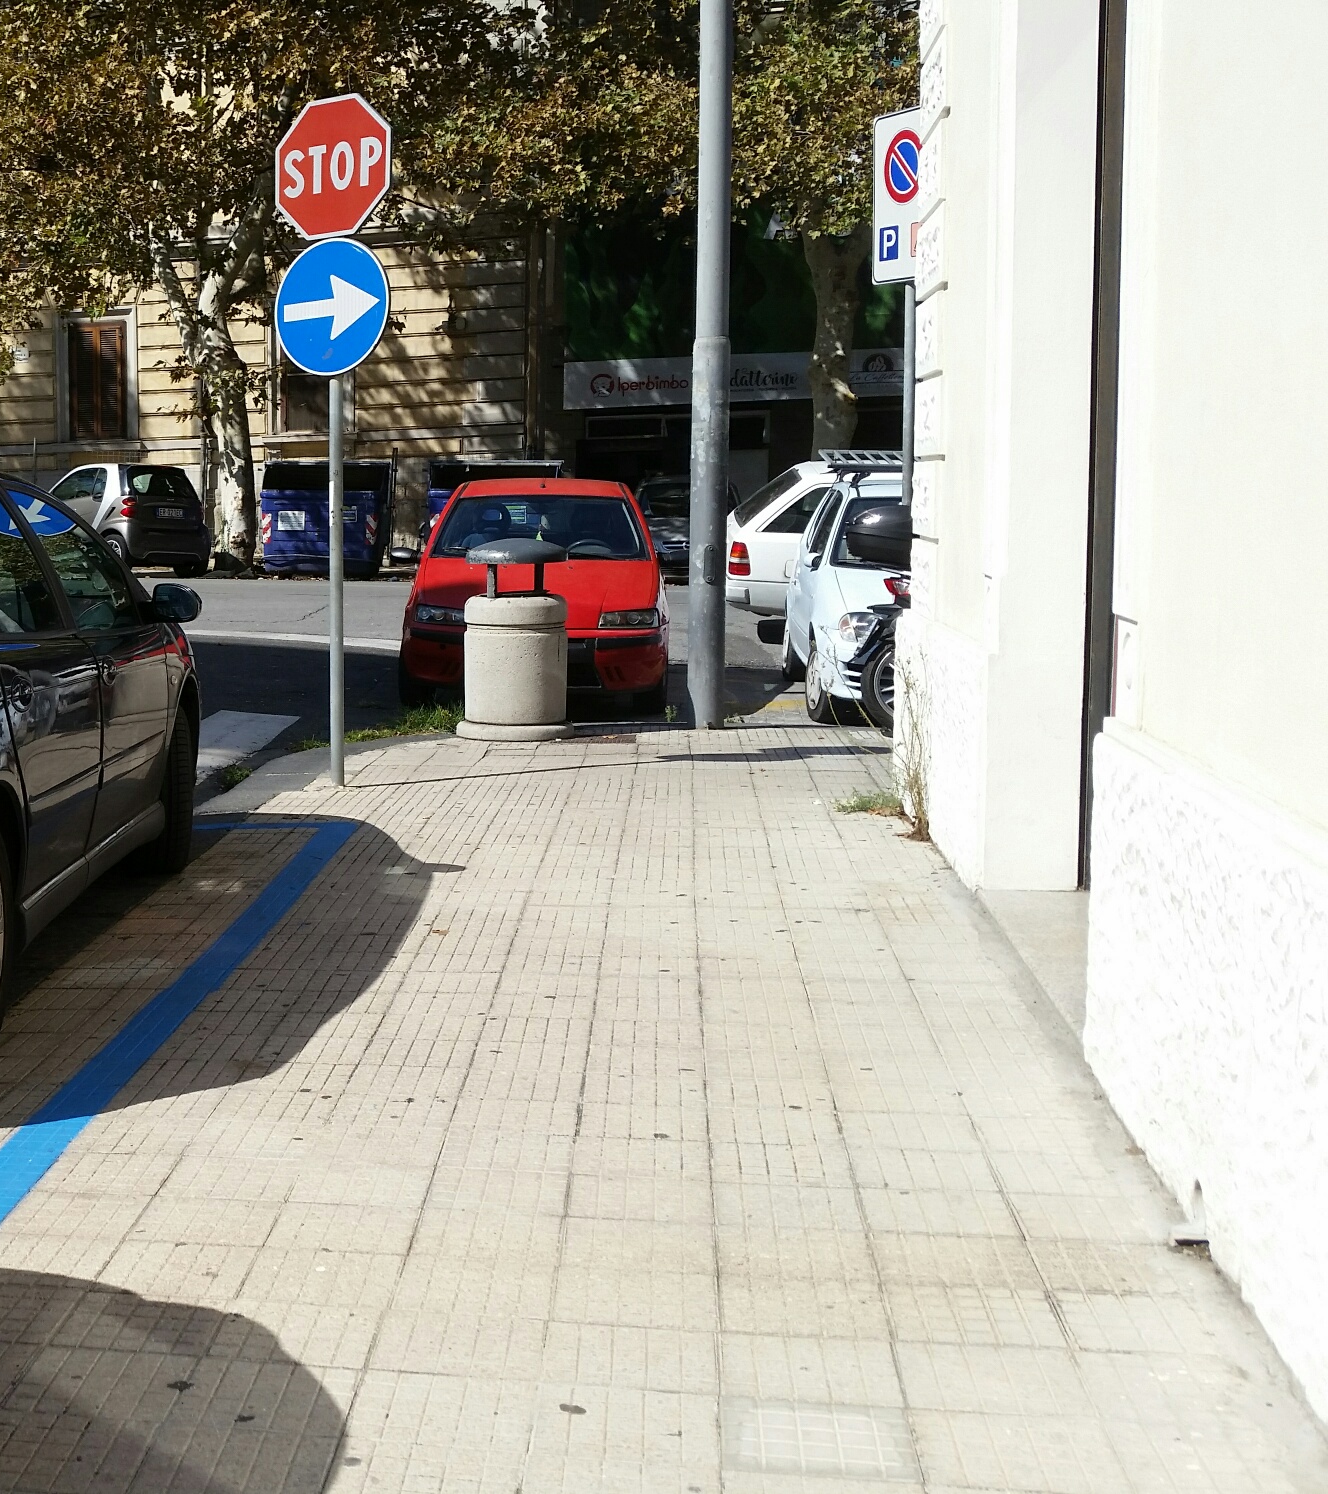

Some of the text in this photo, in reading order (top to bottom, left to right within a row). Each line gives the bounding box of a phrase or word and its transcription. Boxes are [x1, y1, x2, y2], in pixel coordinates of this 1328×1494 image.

[283, 136, 383, 199] STOP
[883, 229, 897, 259] P
[617, 374, 689, 397] Iperbimbo
